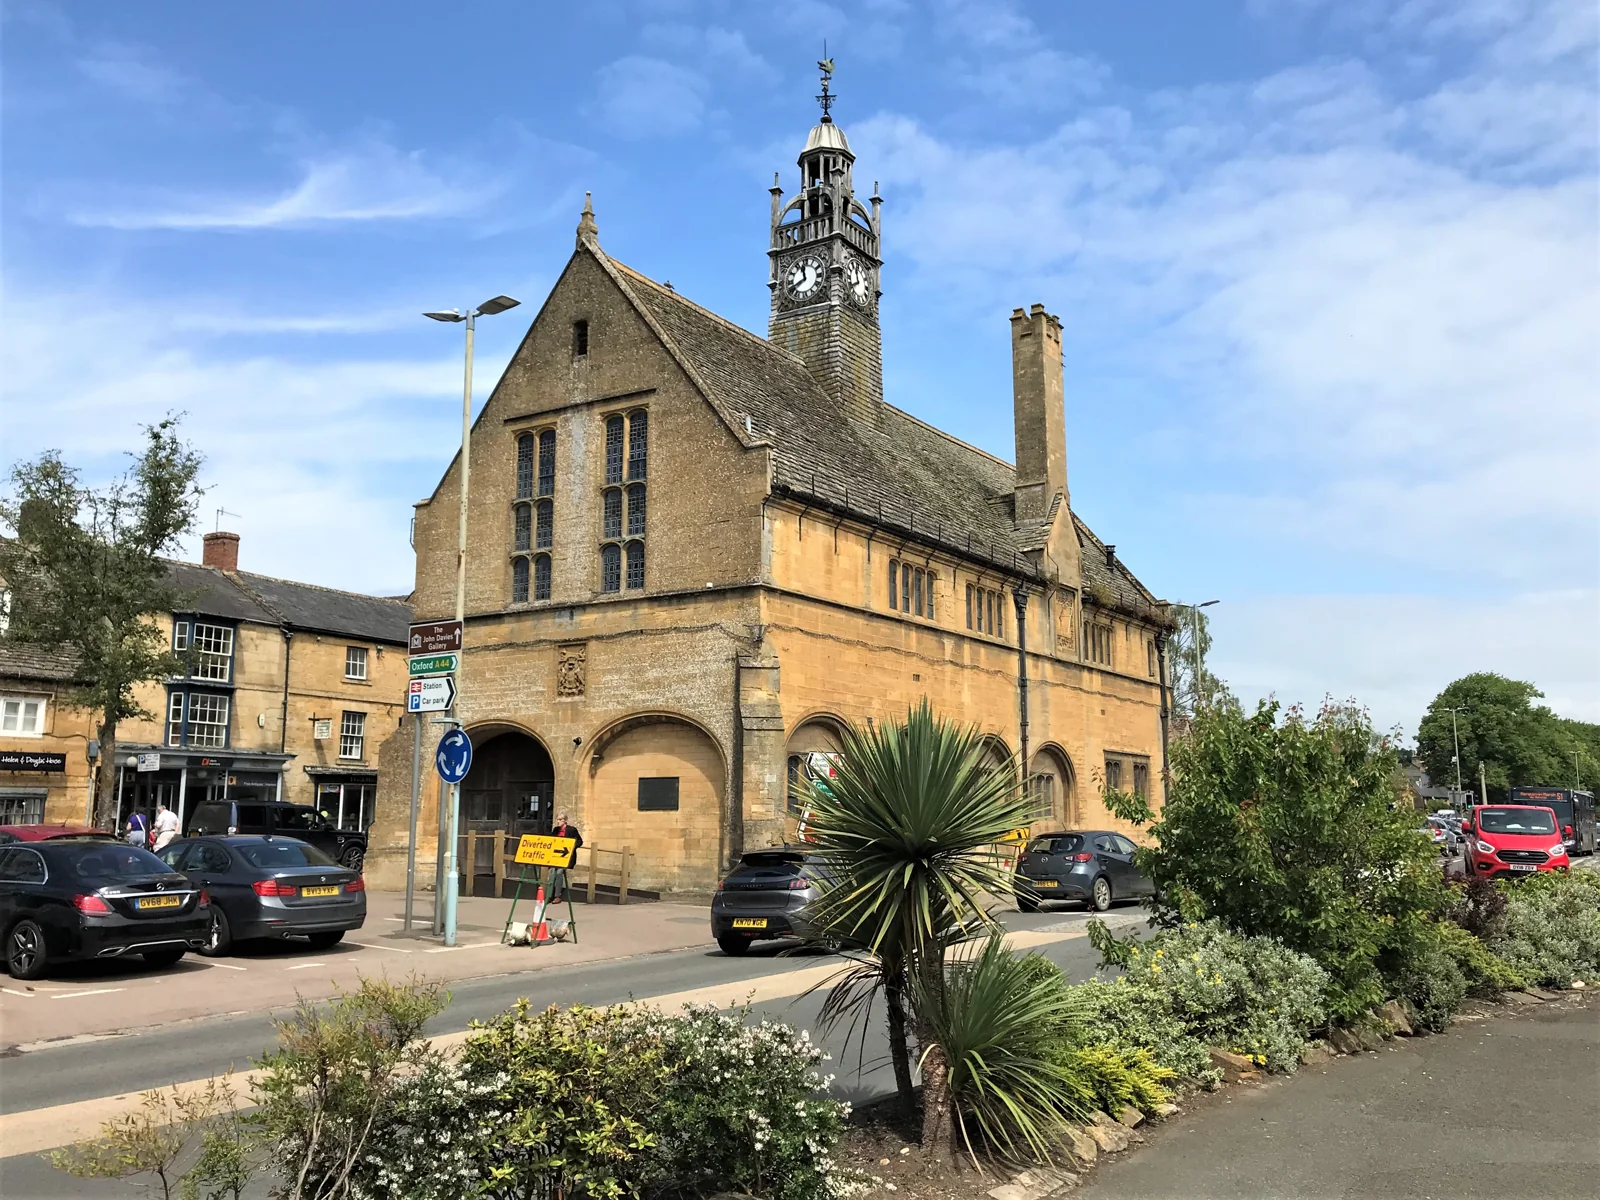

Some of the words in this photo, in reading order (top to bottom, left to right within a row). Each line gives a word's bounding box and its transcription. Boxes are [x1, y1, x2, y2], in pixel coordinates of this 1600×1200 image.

[436, 633, 454, 641] Davies
[411, 661, 433, 671] Oxford
[435, 659, 449, 668] A44
[423, 682, 442, 690] Station
[412, 696, 419, 708] P
[522, 840, 552, 849] Diverted
[523, 850, 545, 859] traffic
[306, 887, 321, 895] BV13
[322, 886, 334, 894] YXF
[140, 897, 161, 907] GV68
[164, 895, 178, 905] JHK
